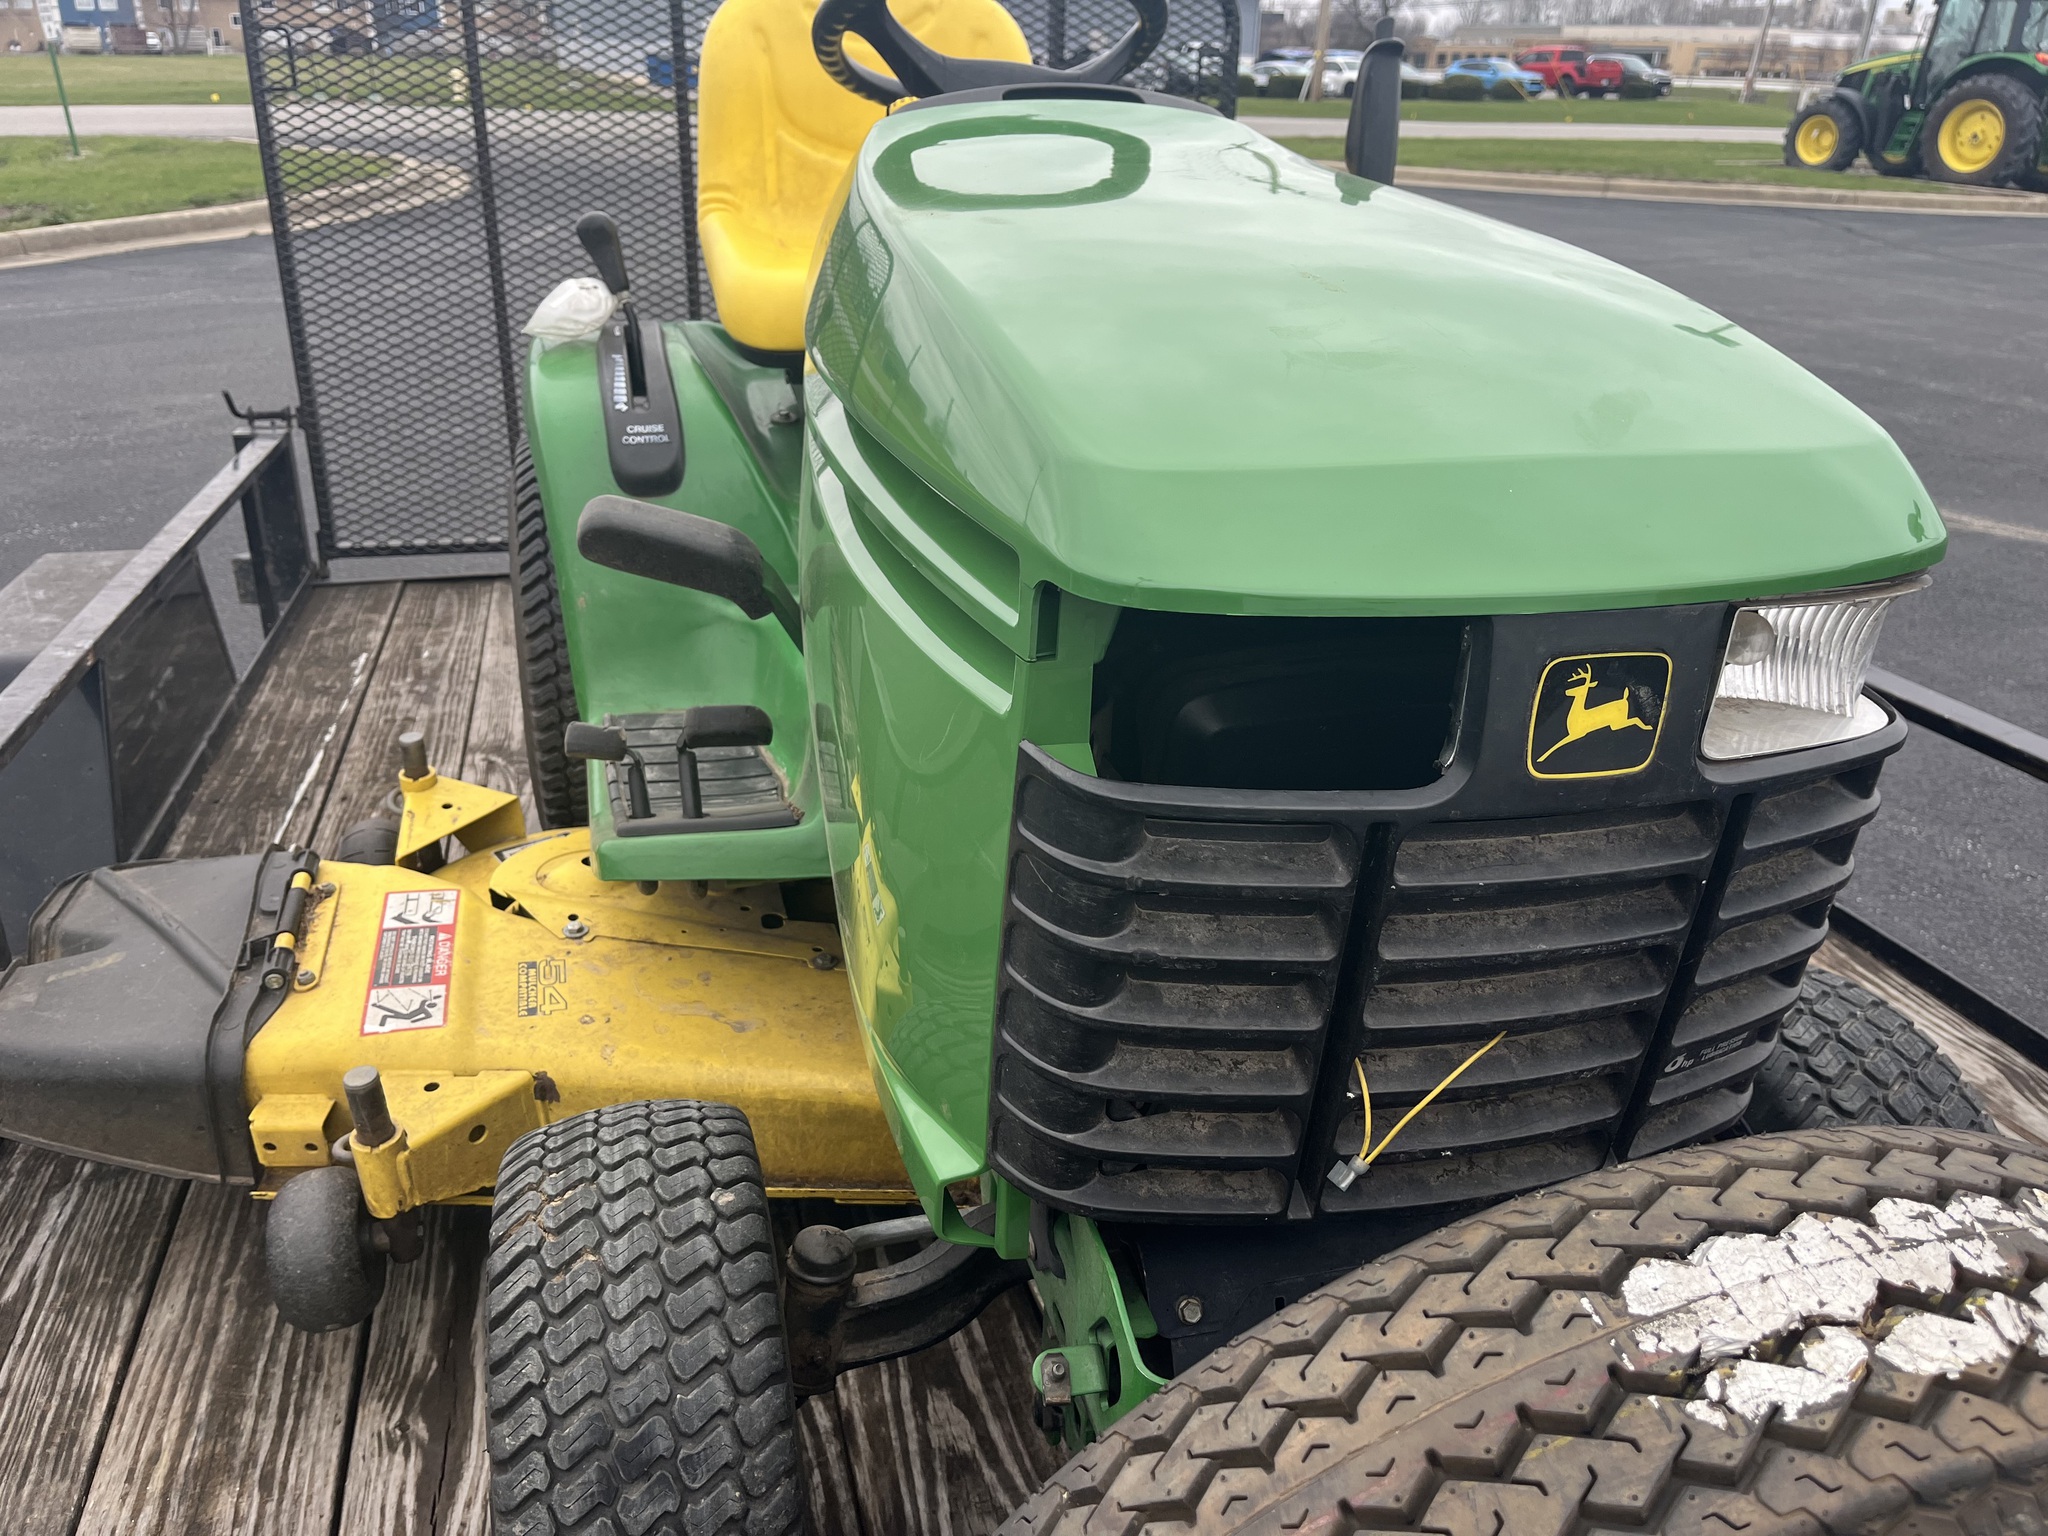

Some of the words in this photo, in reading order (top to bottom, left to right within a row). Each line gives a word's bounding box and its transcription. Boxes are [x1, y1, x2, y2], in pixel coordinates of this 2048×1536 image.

[621, 434, 669, 445] CONTROL
[626, 424, 664, 434] CRUISE
[434, 941, 452, 977] DANGER
[518, 962, 528, 1017] COMPATIBLE
[527, 968, 537, 1009] MULCHER
[538, 959, 568, 1015] 54
